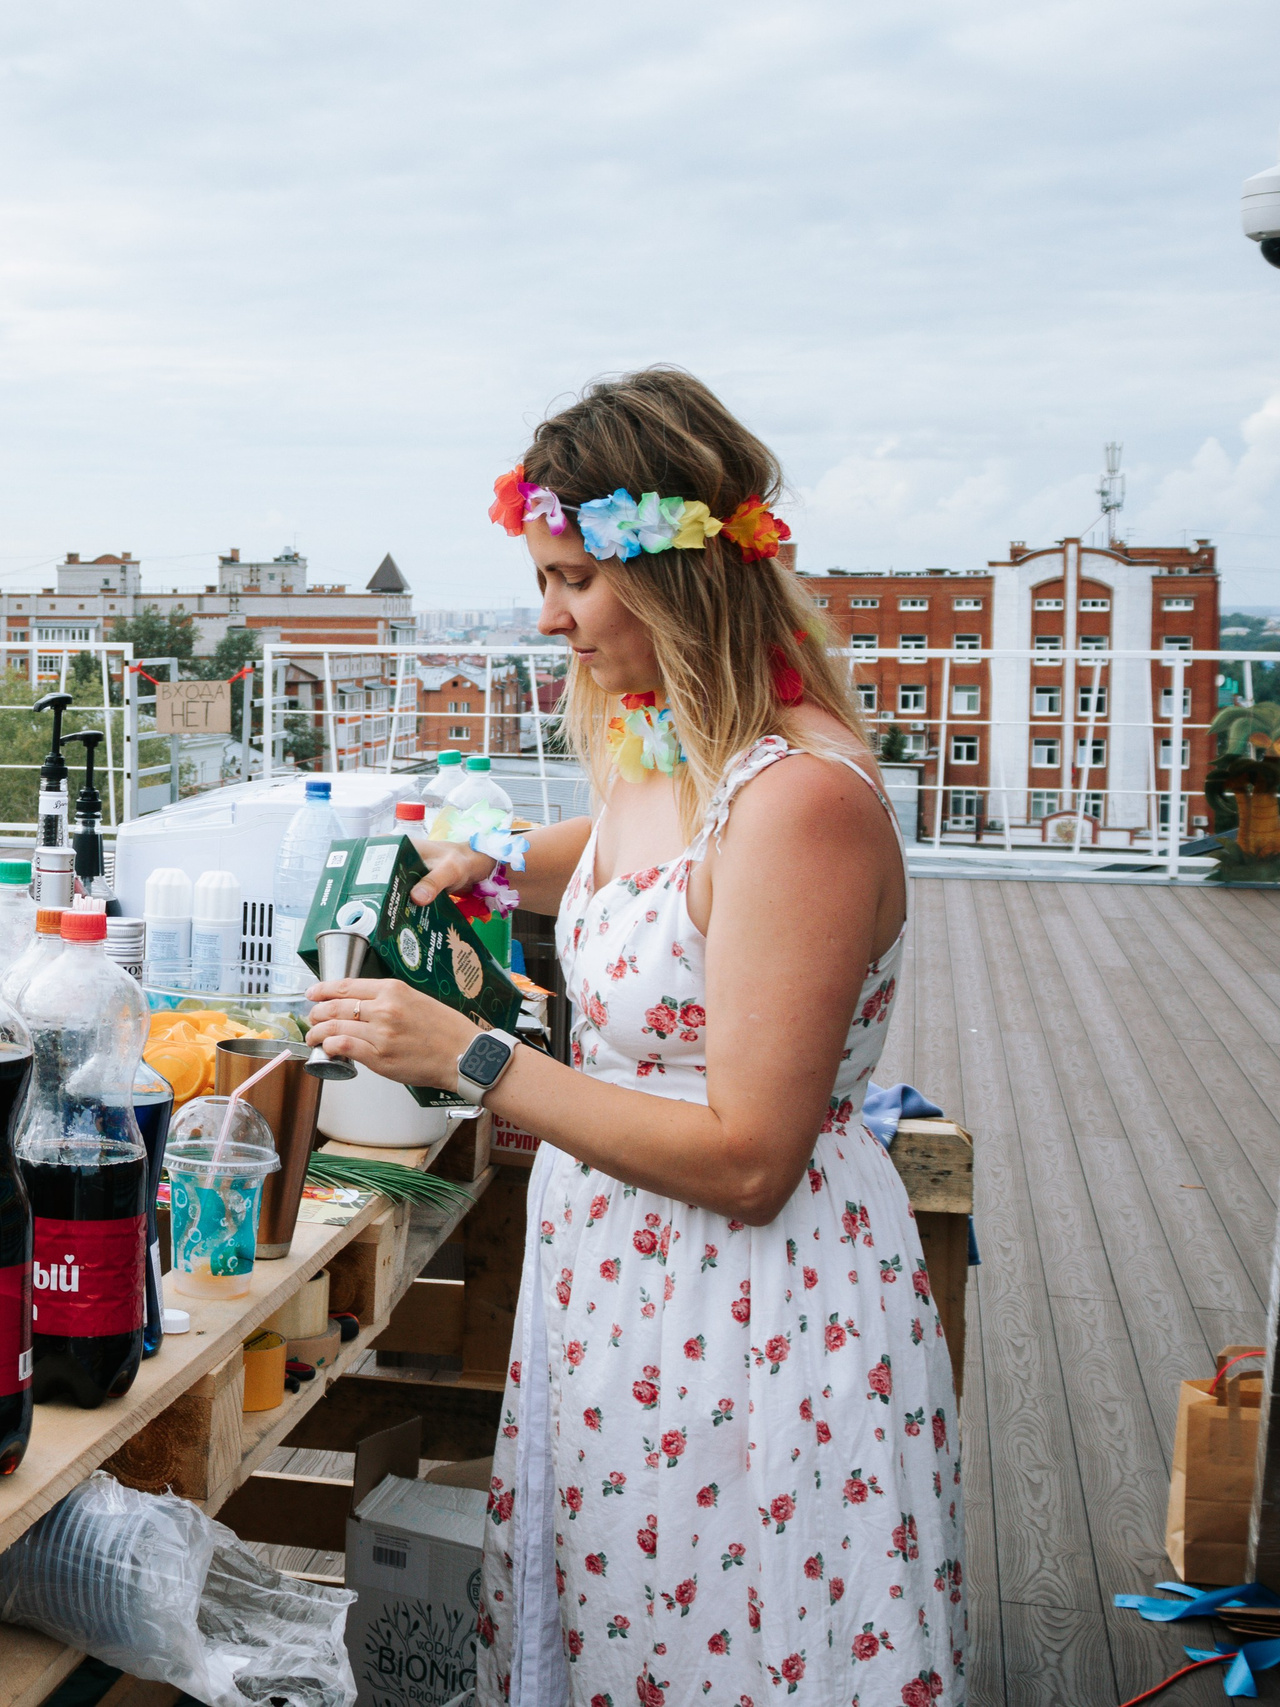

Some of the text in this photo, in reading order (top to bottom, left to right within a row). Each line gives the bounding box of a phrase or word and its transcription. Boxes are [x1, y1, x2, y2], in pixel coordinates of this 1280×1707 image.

[161, 684, 225, 700] ВХОДА
[171, 700, 215, 727] НЕТ
[320, 878, 334, 906] ананас
[387, 875, 400, 917] БОЛЬШЕ
[389, 892, 401, 930] ПОЛЬЗЫ
[425, 929, 437, 973] БОЛЬШЕ
[435, 931, 444, 950] СИЛ
[465, 1054, 486, 1076] 18
[415, 1639, 461, 1660] VODKA
